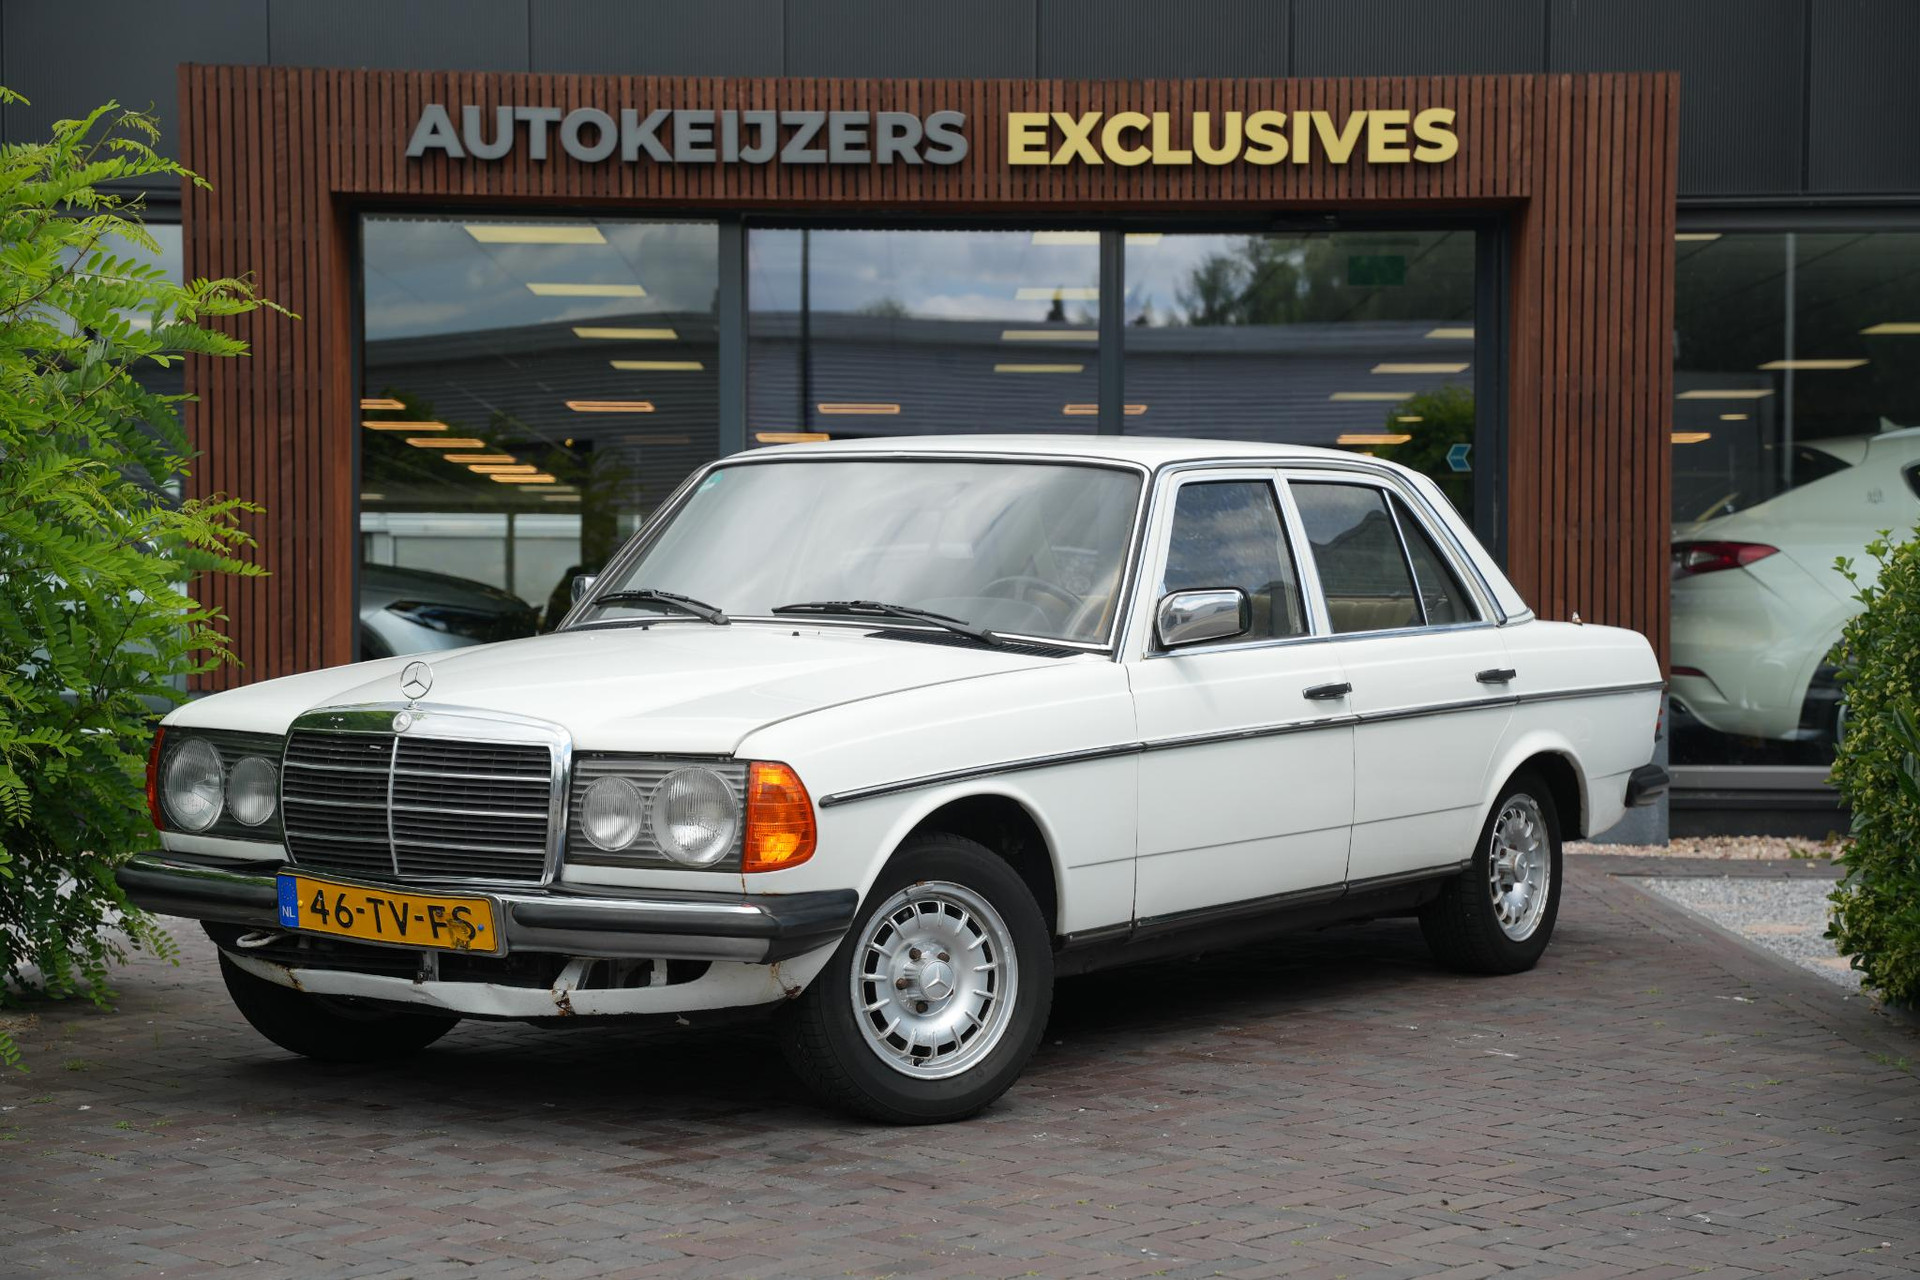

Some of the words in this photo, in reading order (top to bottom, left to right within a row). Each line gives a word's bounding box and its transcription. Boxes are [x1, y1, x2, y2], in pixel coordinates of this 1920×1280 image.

[405, 104, 968, 164] AUTOKEIJZERS
[1008, 107, 1459, 166] EXCLUSIVES
[282, 906, 296, 918] NL
[310, 889, 476, 941] 46-TV-FS
